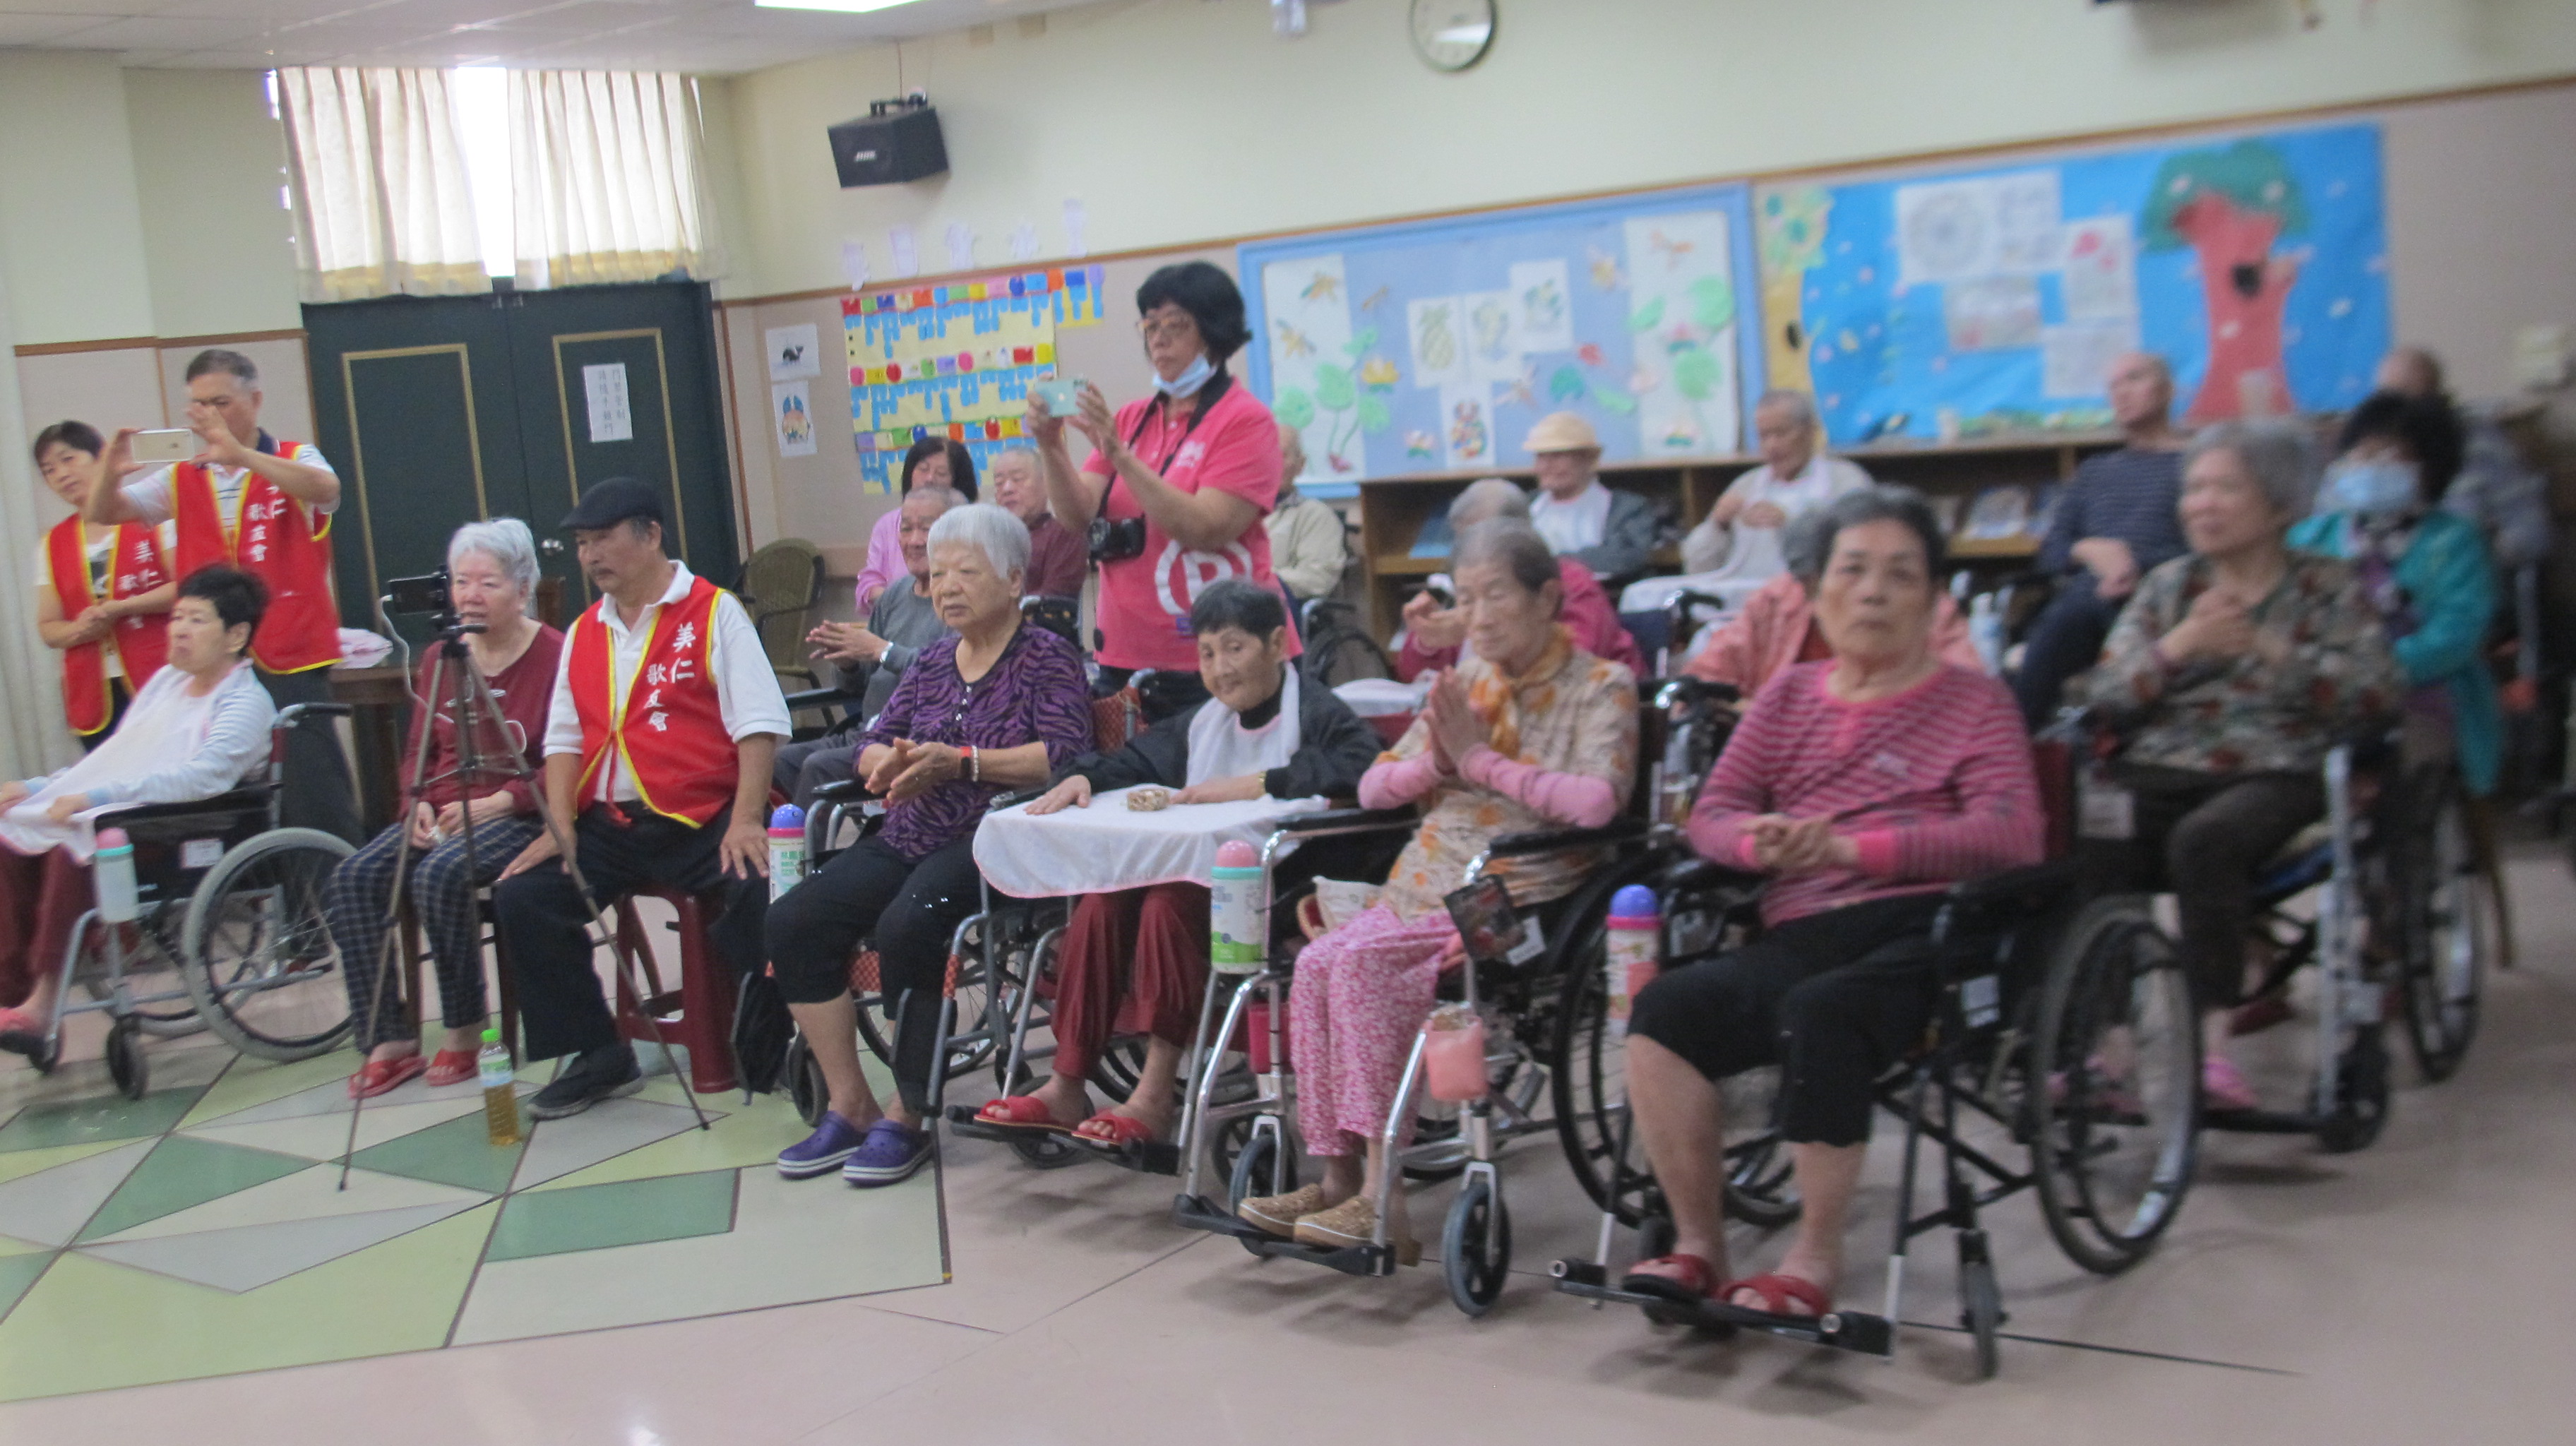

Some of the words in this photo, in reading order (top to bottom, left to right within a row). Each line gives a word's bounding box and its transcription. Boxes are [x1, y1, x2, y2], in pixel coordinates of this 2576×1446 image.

[671, 621, 696, 683] 美仁
[644, 663, 669, 732] 歌友會
